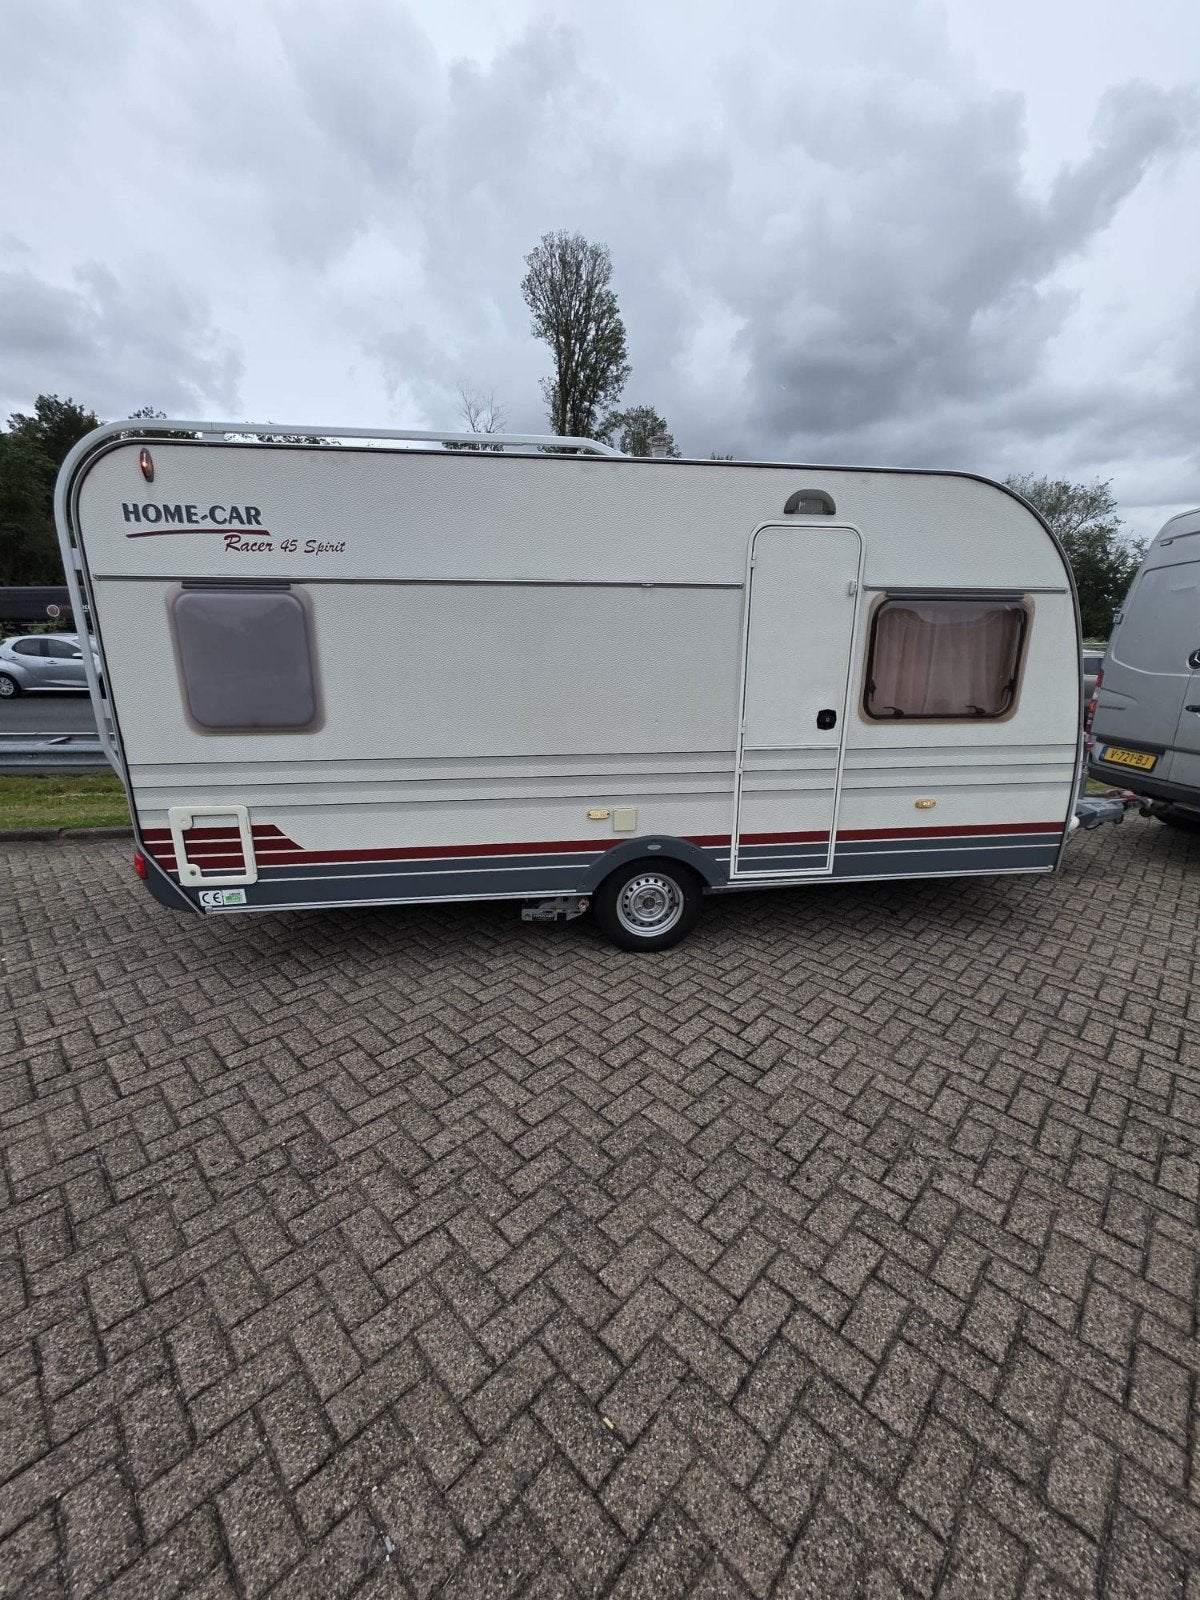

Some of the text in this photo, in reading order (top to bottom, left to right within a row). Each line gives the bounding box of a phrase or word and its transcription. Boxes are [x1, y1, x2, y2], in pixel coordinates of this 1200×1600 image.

[122, 503, 262, 526] HOME-CAR
[223, 533, 346, 556] Racer 45 Spirit
[1110, 749, 1150, 766] V-721-BJ
[202, 892, 221, 904] CE
